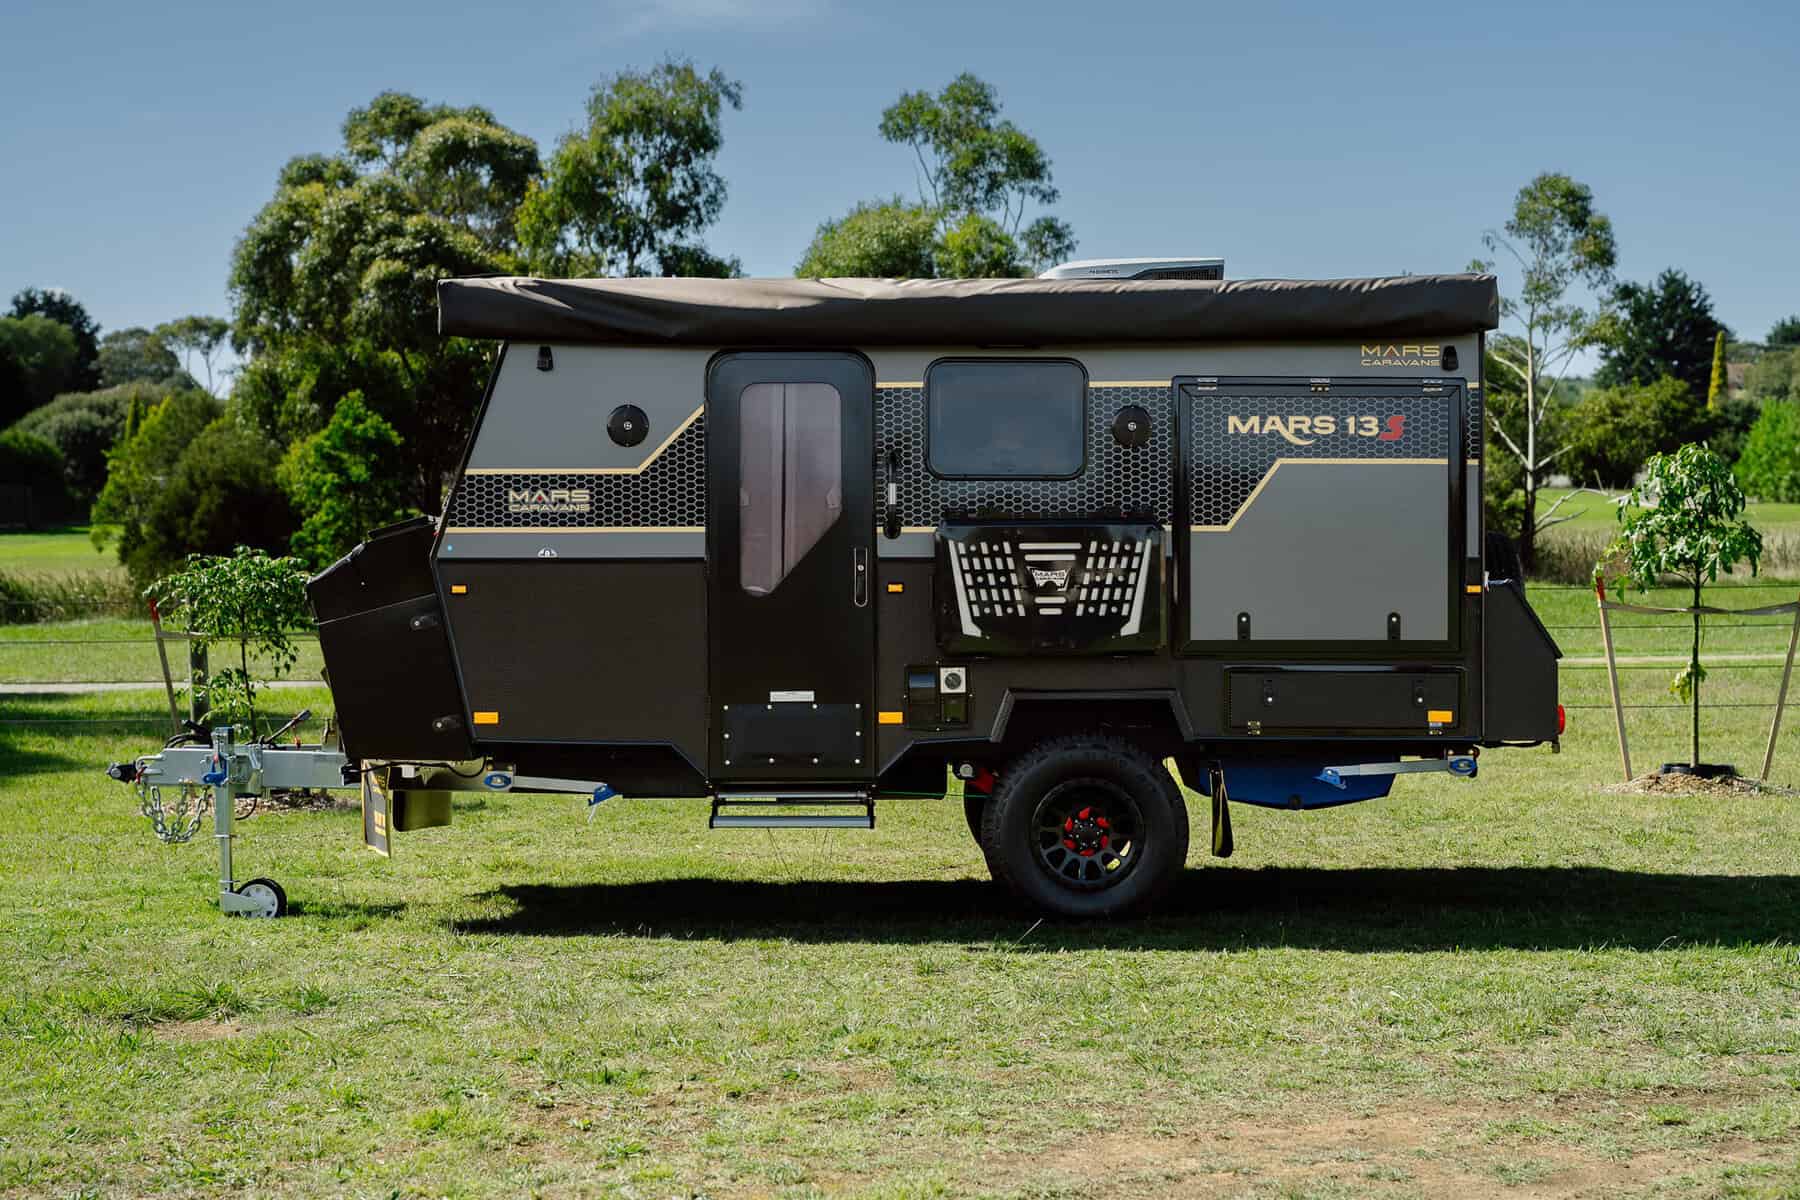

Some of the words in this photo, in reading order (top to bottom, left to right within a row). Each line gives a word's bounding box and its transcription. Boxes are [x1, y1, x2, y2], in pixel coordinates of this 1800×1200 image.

[1361, 345, 1440, 357] MARS
[1228, 415, 1336, 446] MARS
[508, 490, 590, 503] MARS
[508, 504, 590, 512] CARAVANS
